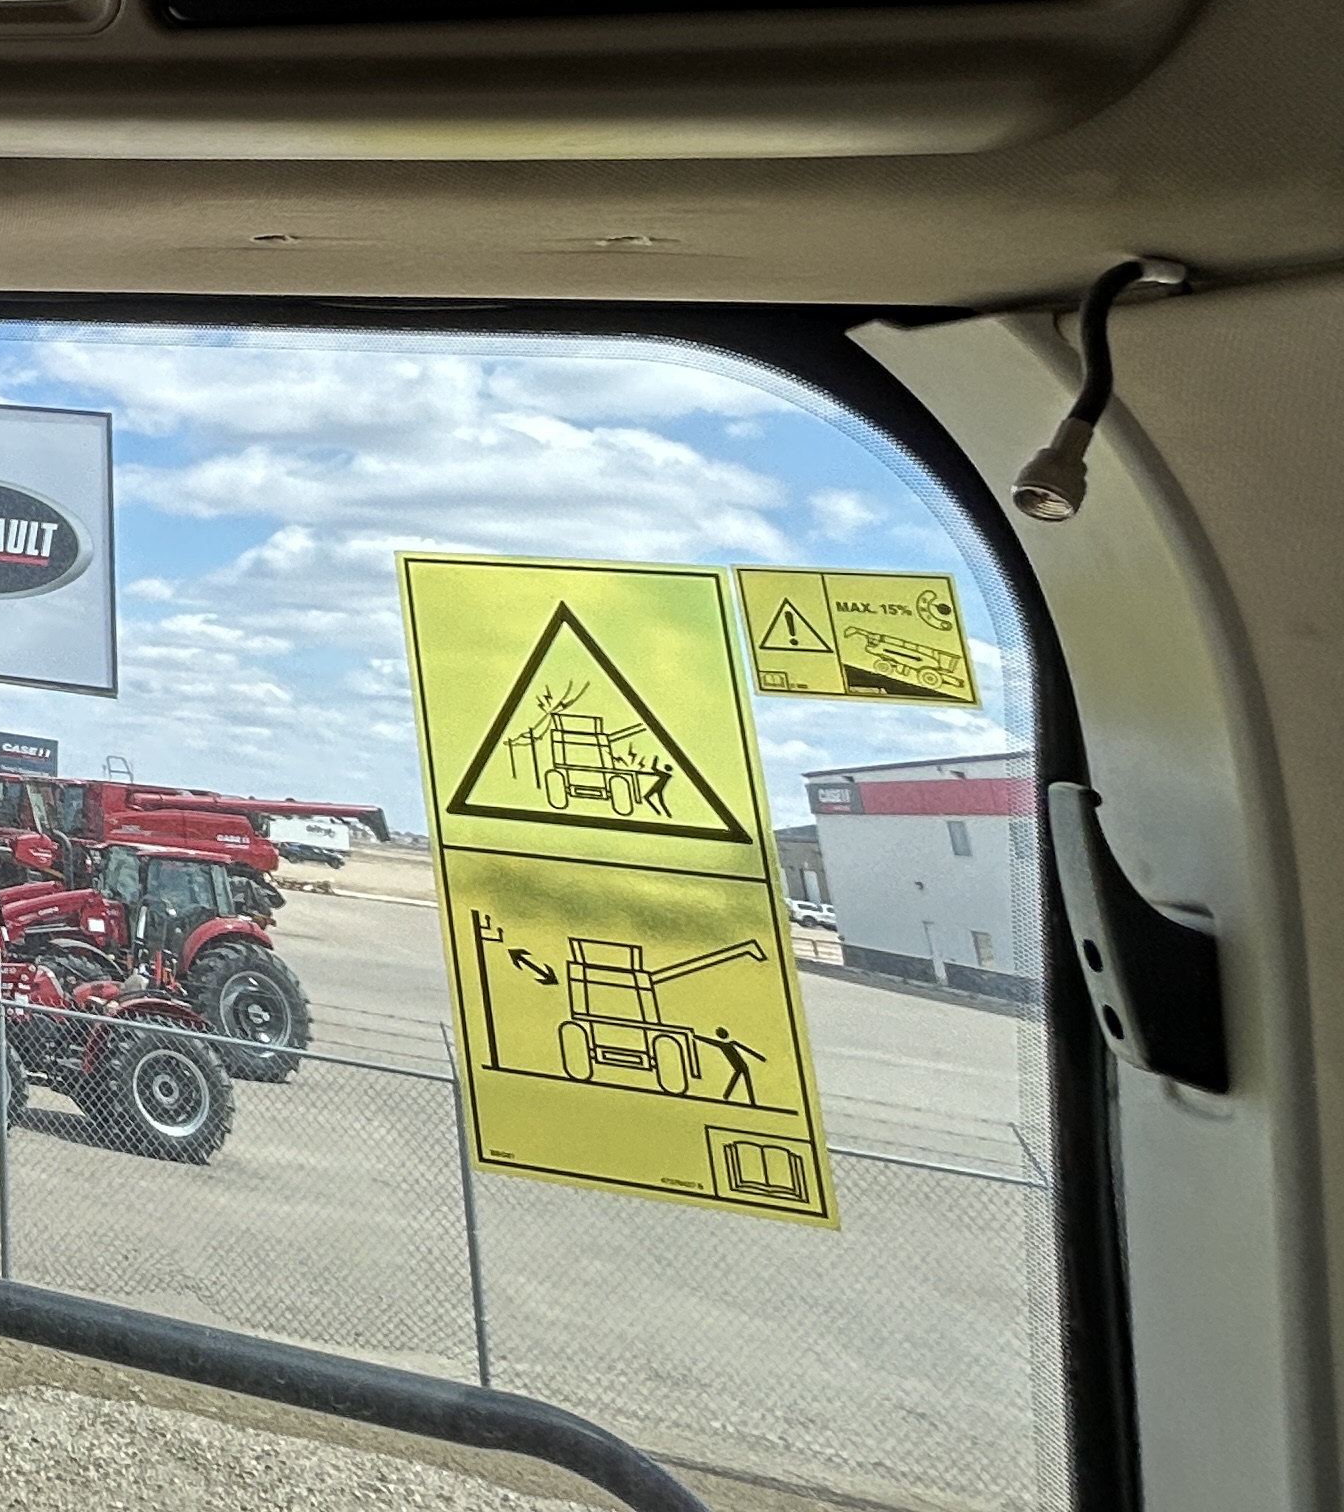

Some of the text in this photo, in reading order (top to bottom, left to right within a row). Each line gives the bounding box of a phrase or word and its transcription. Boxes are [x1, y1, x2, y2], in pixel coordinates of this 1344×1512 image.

[835, 601, 913, 616] MAX. 15%
[2, 742, 37, 756] CASE
